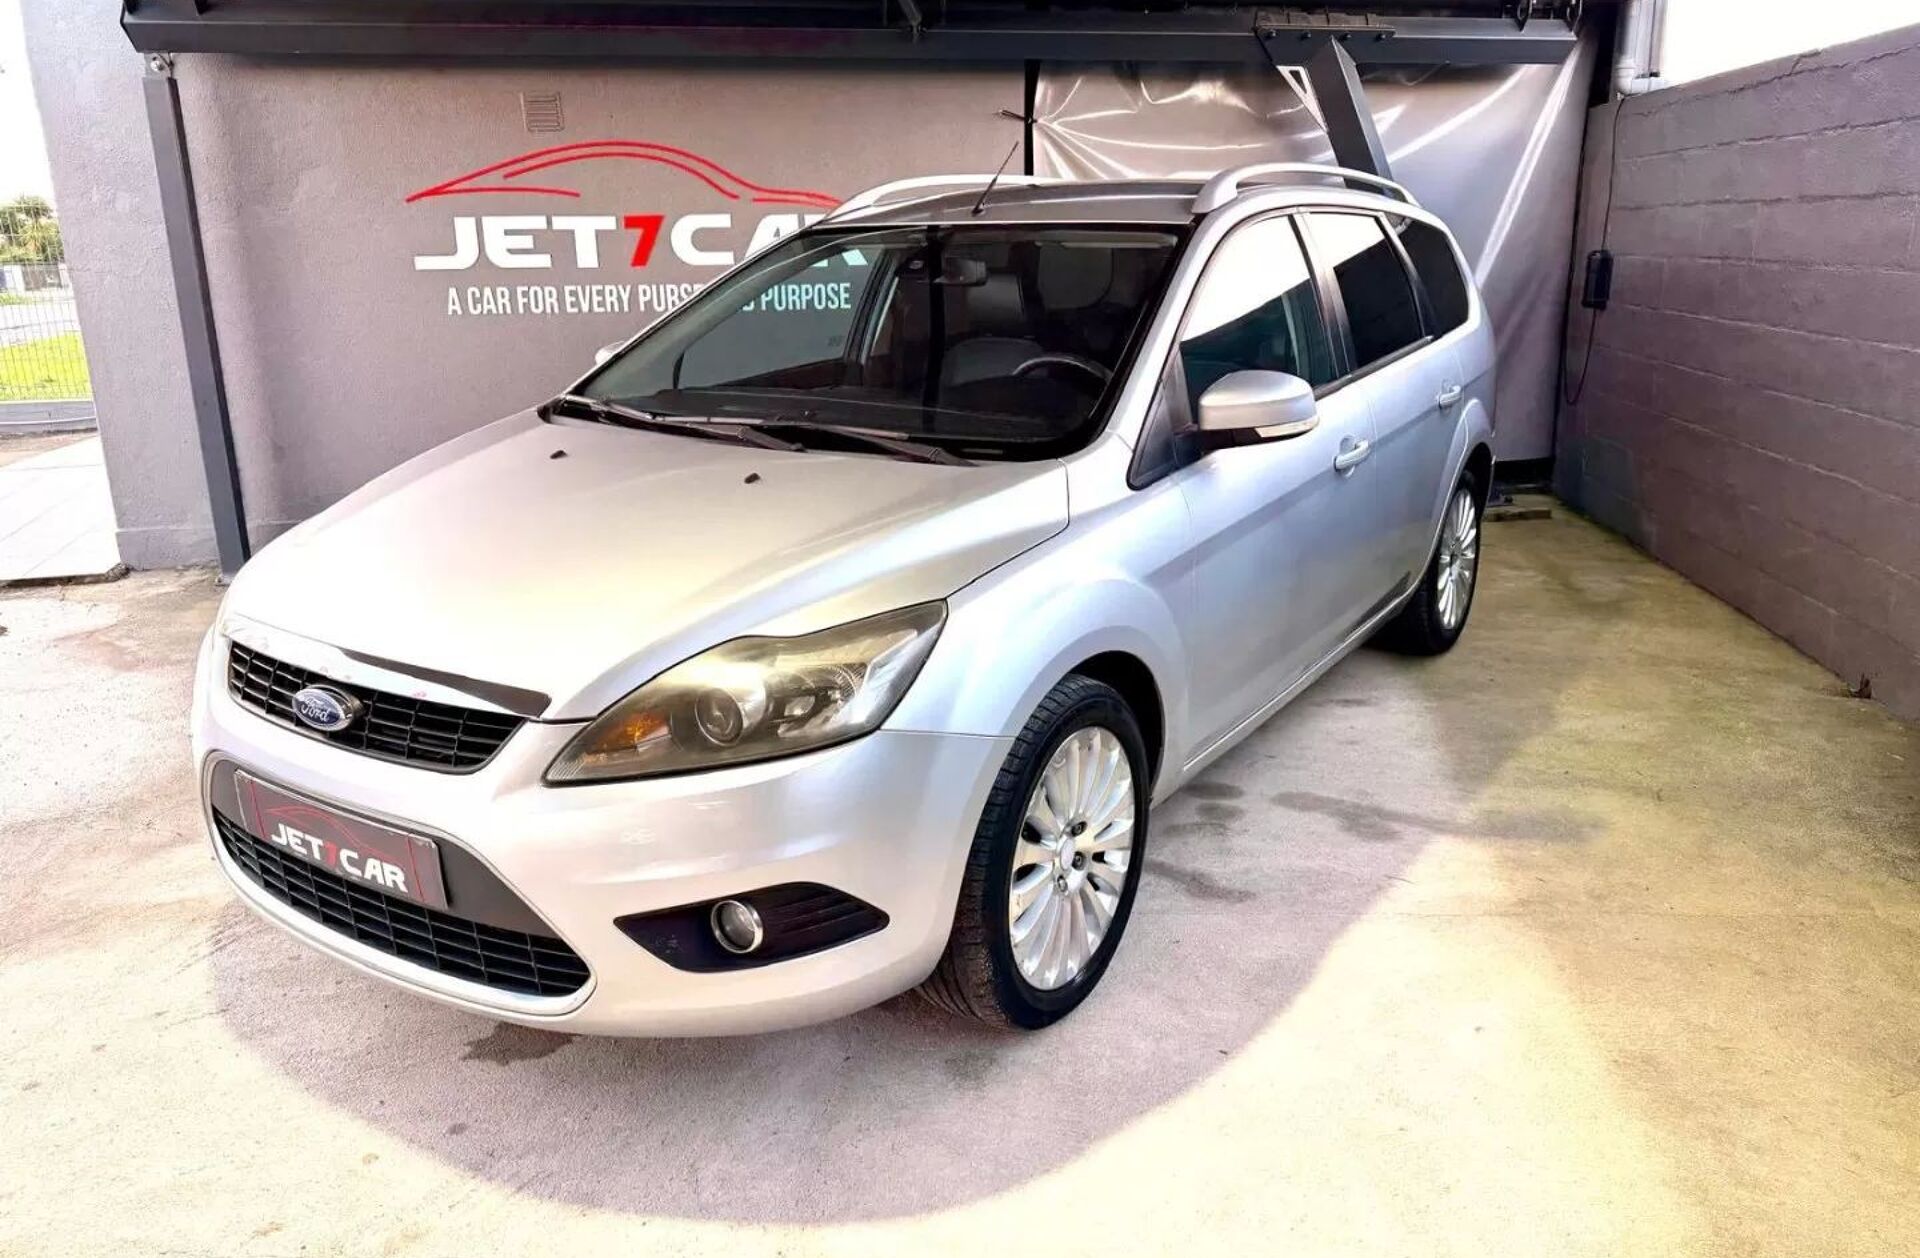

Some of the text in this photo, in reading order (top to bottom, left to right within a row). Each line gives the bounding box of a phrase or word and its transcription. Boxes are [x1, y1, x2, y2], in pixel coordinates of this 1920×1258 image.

[447, 287, 463, 315] A
[466, 286, 512, 315] CAR
[516, 286, 560, 314] FOR
[564, 284, 632, 314] EVERY
[761, 283, 851, 311] PURPOSE
